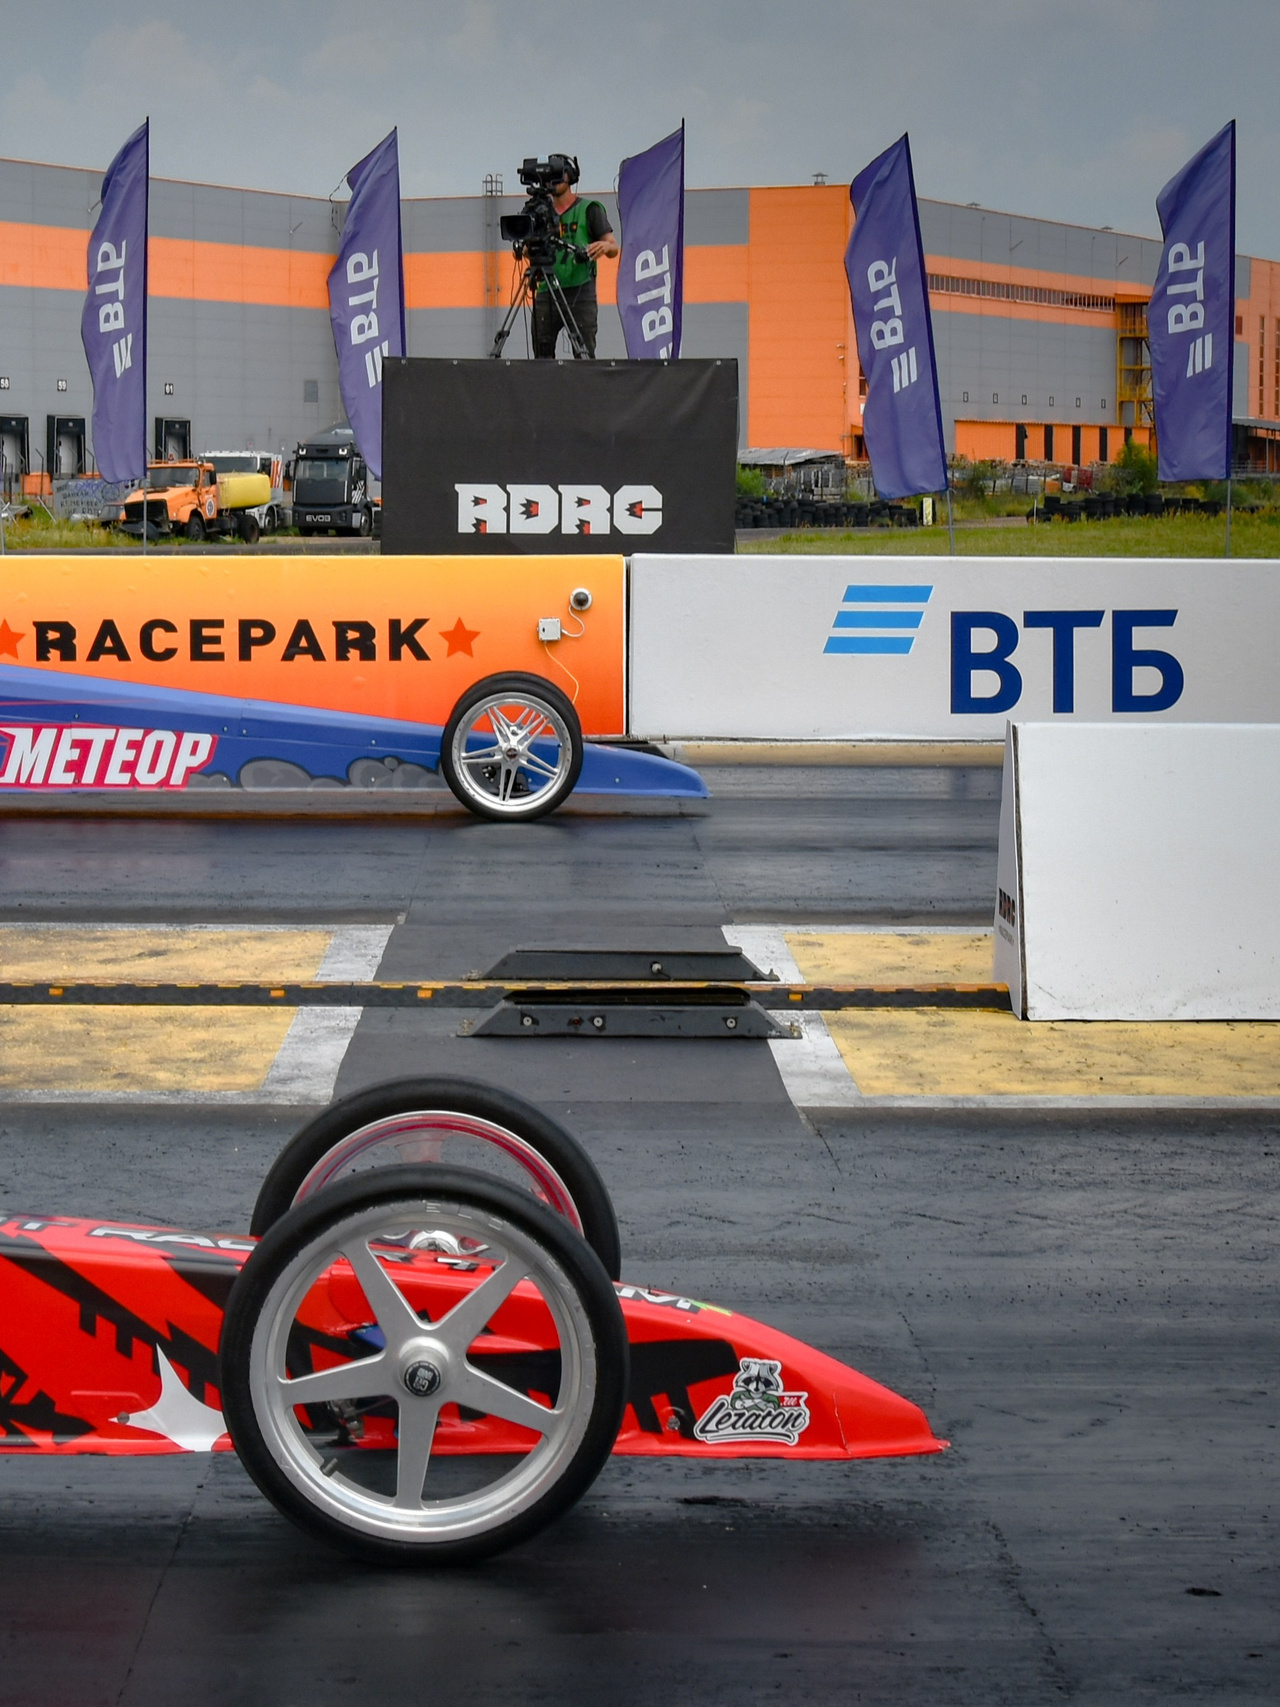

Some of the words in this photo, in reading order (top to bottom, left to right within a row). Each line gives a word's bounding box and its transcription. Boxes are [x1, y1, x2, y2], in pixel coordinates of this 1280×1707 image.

[0, 378, 9, 389] 58
[58, 380, 67, 391] 59
[165, 384, 173, 394] 61
[454, 483, 663, 535] RDRC
[32, 618, 431, 663] RACEPARK
[950, 609, 1185, 714] ВТБ
